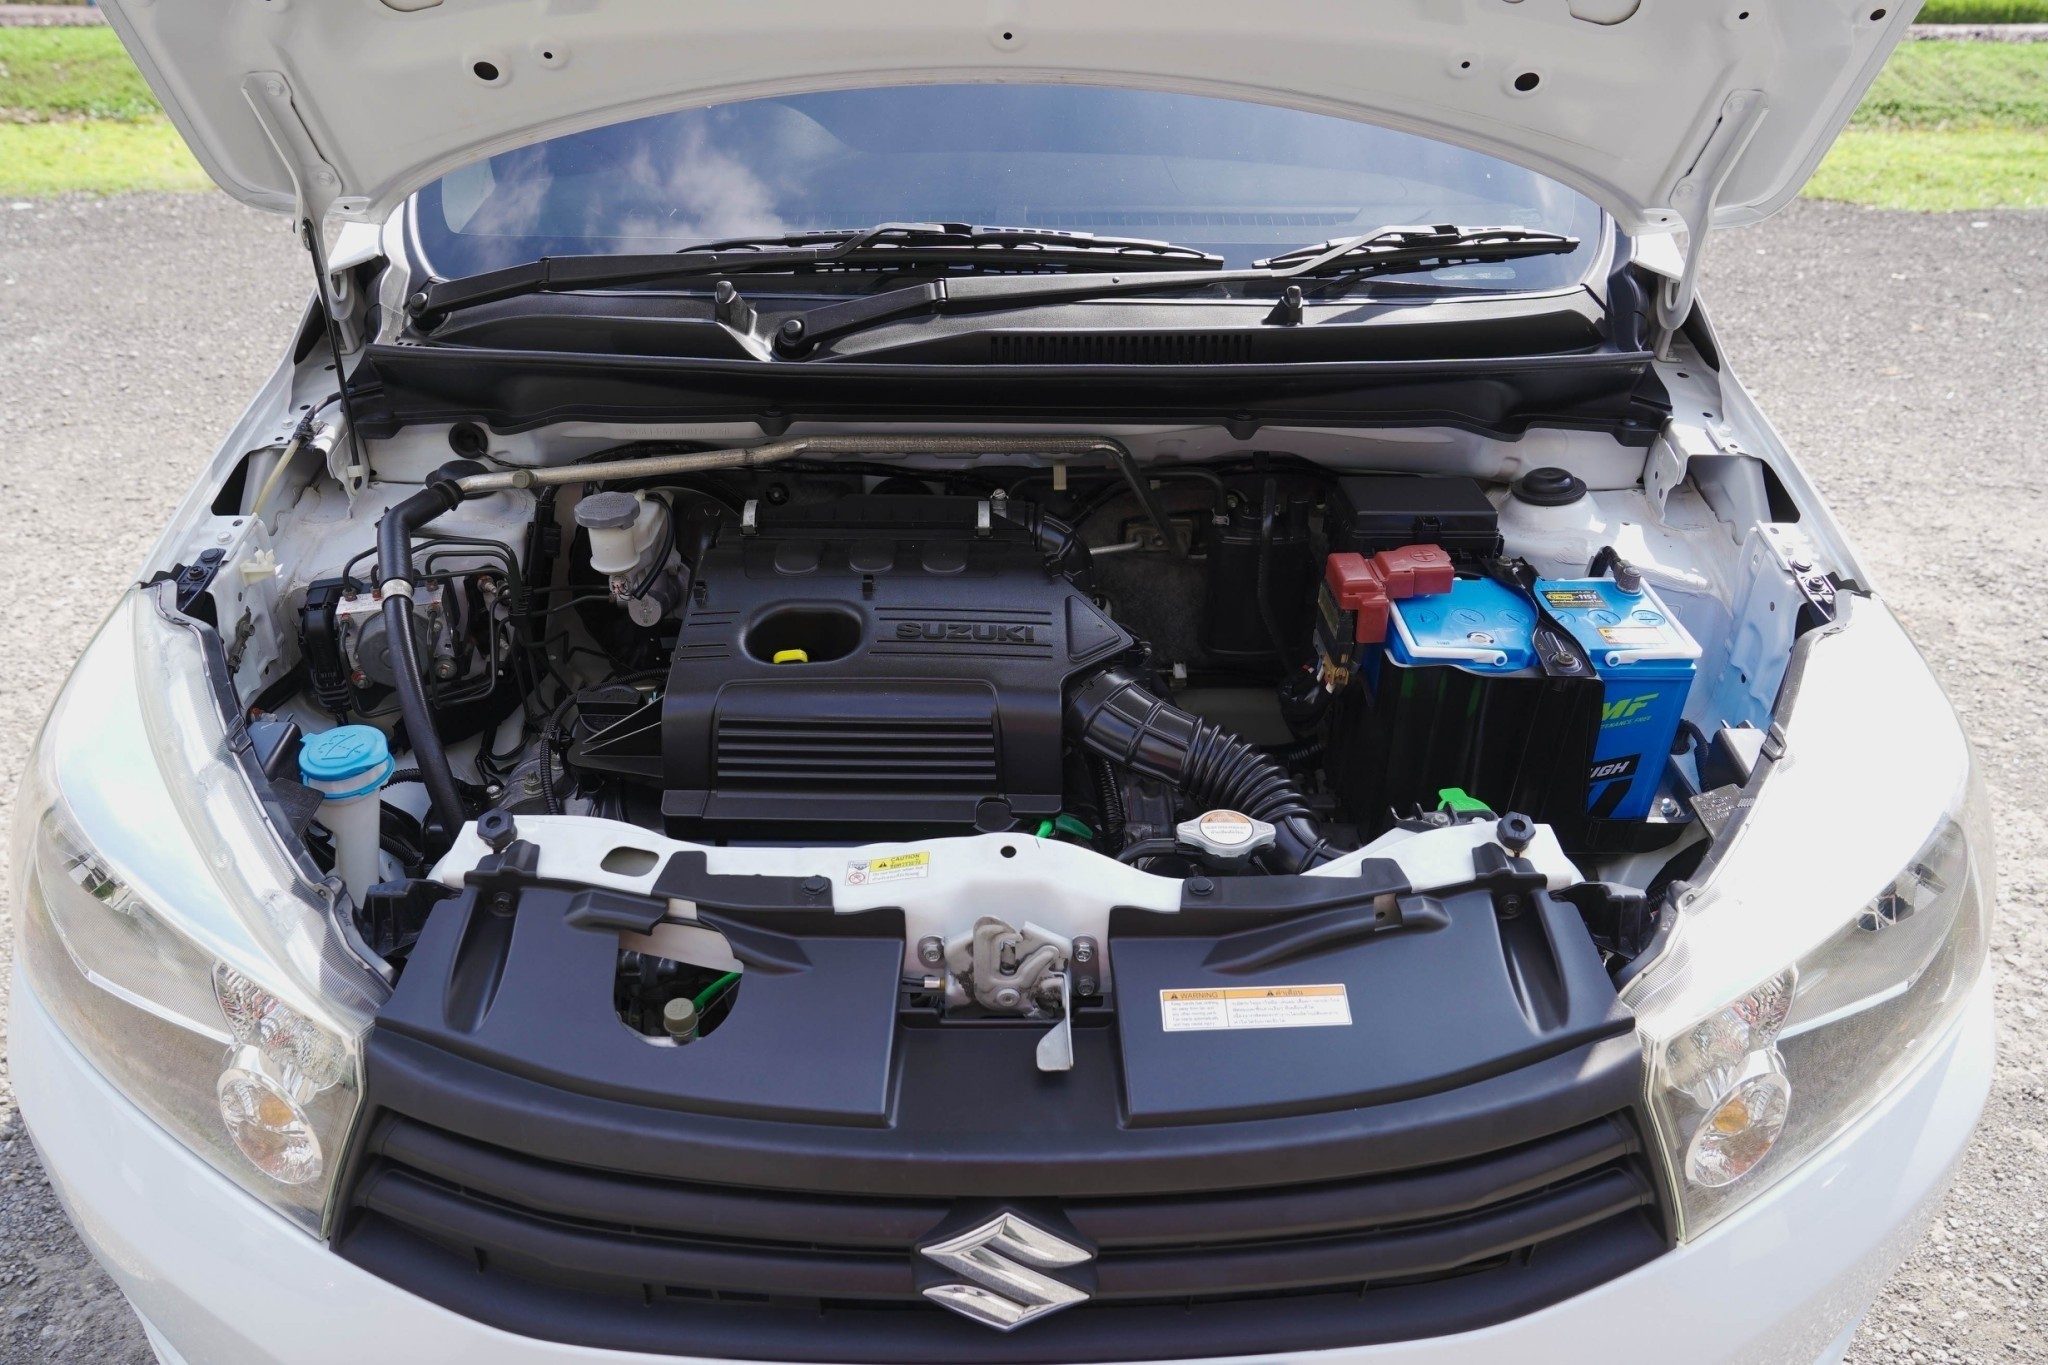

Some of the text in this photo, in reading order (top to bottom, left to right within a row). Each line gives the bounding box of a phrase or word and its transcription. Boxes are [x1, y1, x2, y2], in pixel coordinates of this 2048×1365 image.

[896, 622, 1035, 643] SUZUKI
[1590, 760, 1630, 779] IGH
[890, 853, 920, 862] CAUTION
[1180, 991, 1219, 999] WARNING
